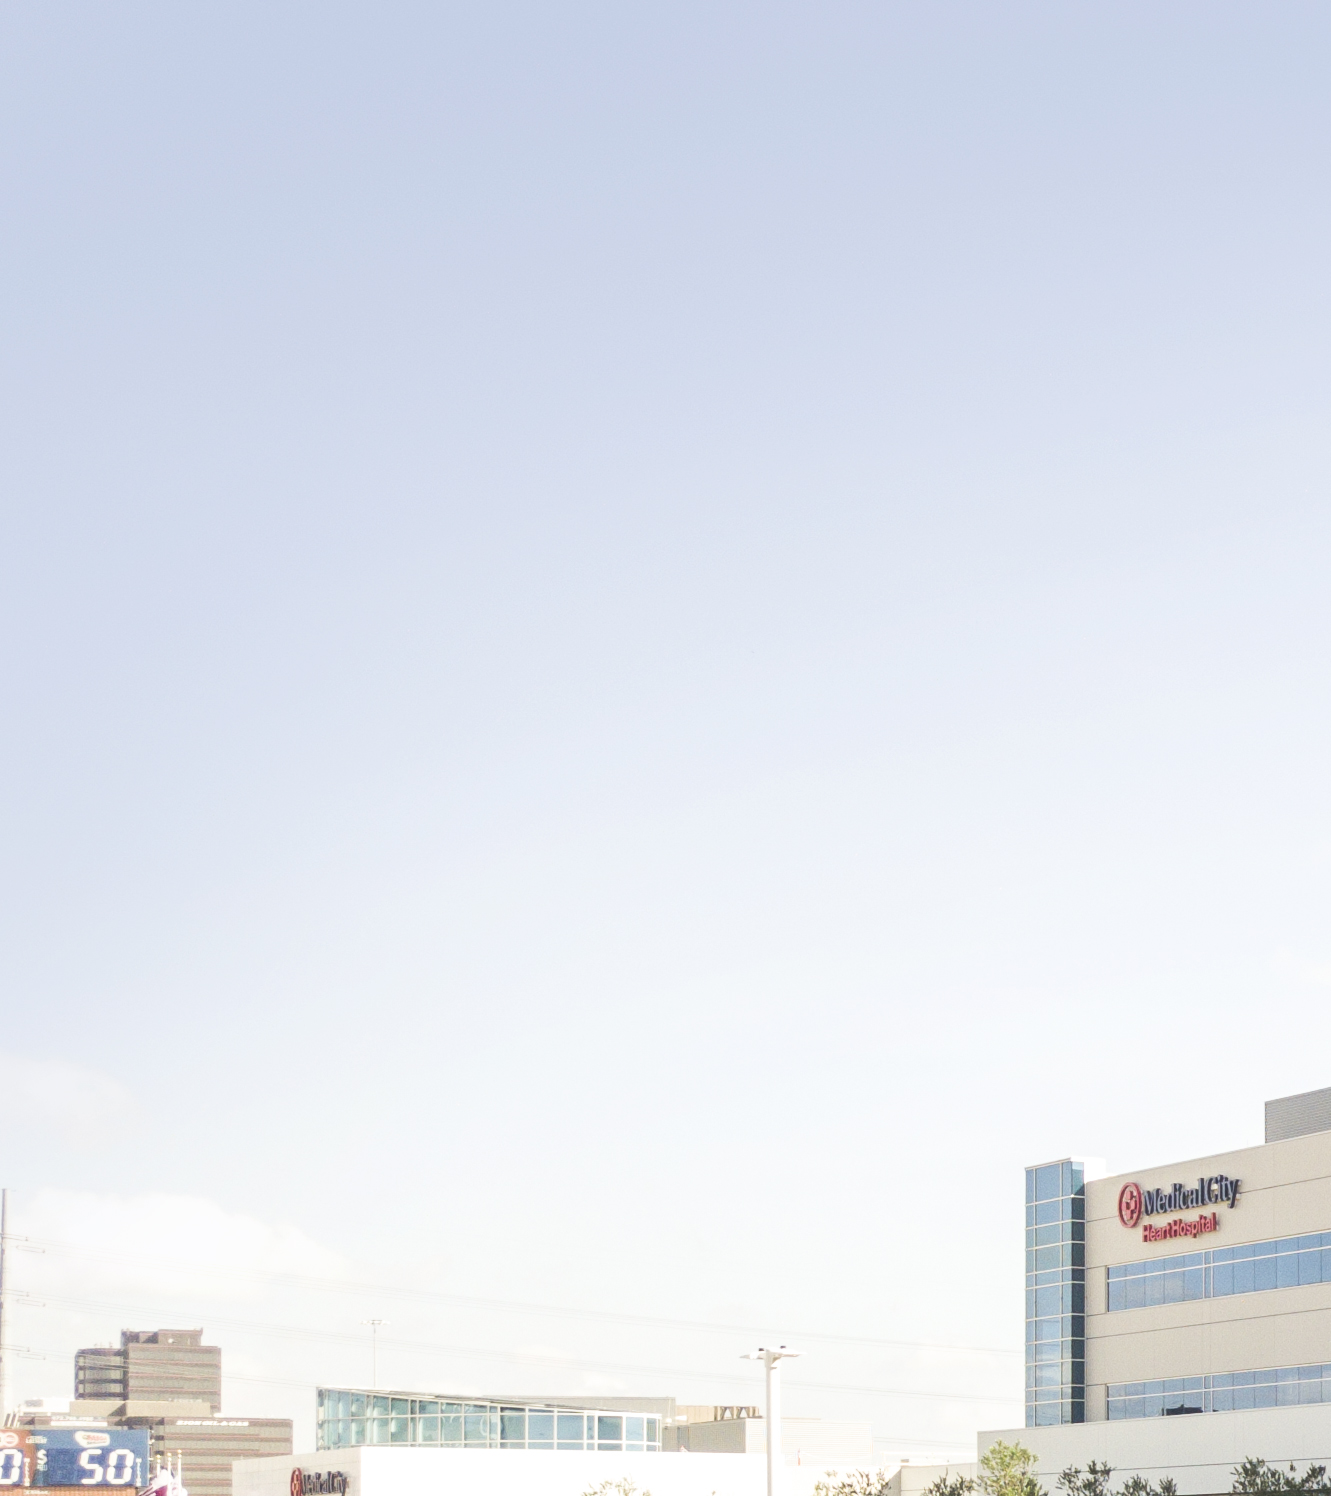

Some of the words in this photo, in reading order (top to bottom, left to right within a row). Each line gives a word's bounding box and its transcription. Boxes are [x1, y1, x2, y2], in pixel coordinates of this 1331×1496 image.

[1142, 1177, 1205, 1217] Medical
[1204, 1174, 1241, 1209] City
[1142, 1221, 1172, 1242] Heart
[1171, 1212, 1217, 1239] Hospital
[80, 1449, 135, 1484] 50
